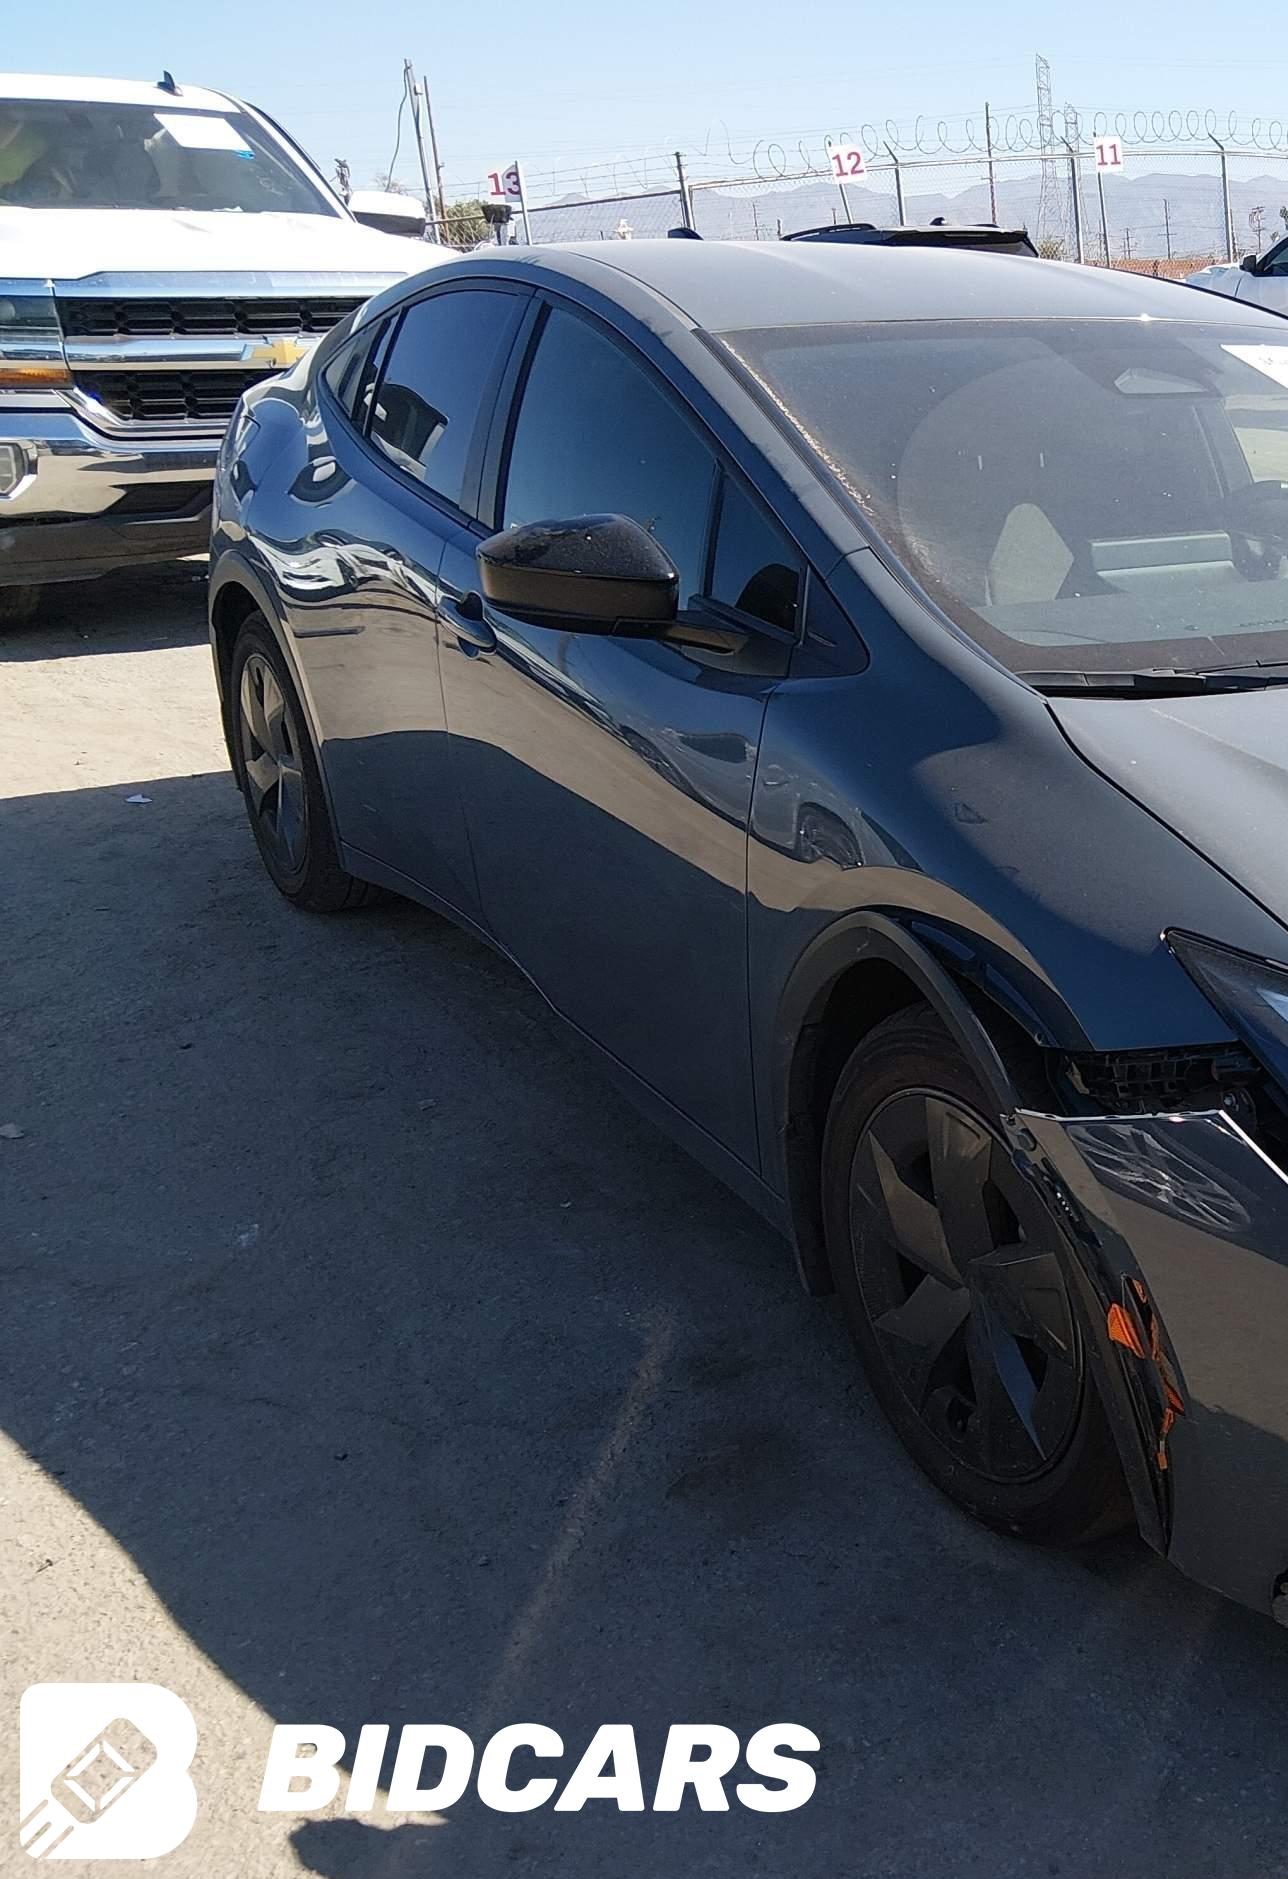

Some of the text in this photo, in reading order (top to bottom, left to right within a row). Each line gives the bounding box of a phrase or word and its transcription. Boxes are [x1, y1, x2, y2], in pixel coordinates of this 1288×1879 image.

[832, 152, 865, 177] 12
[1097, 144, 1121, 166] 11
[487, 171, 521, 196] 13
